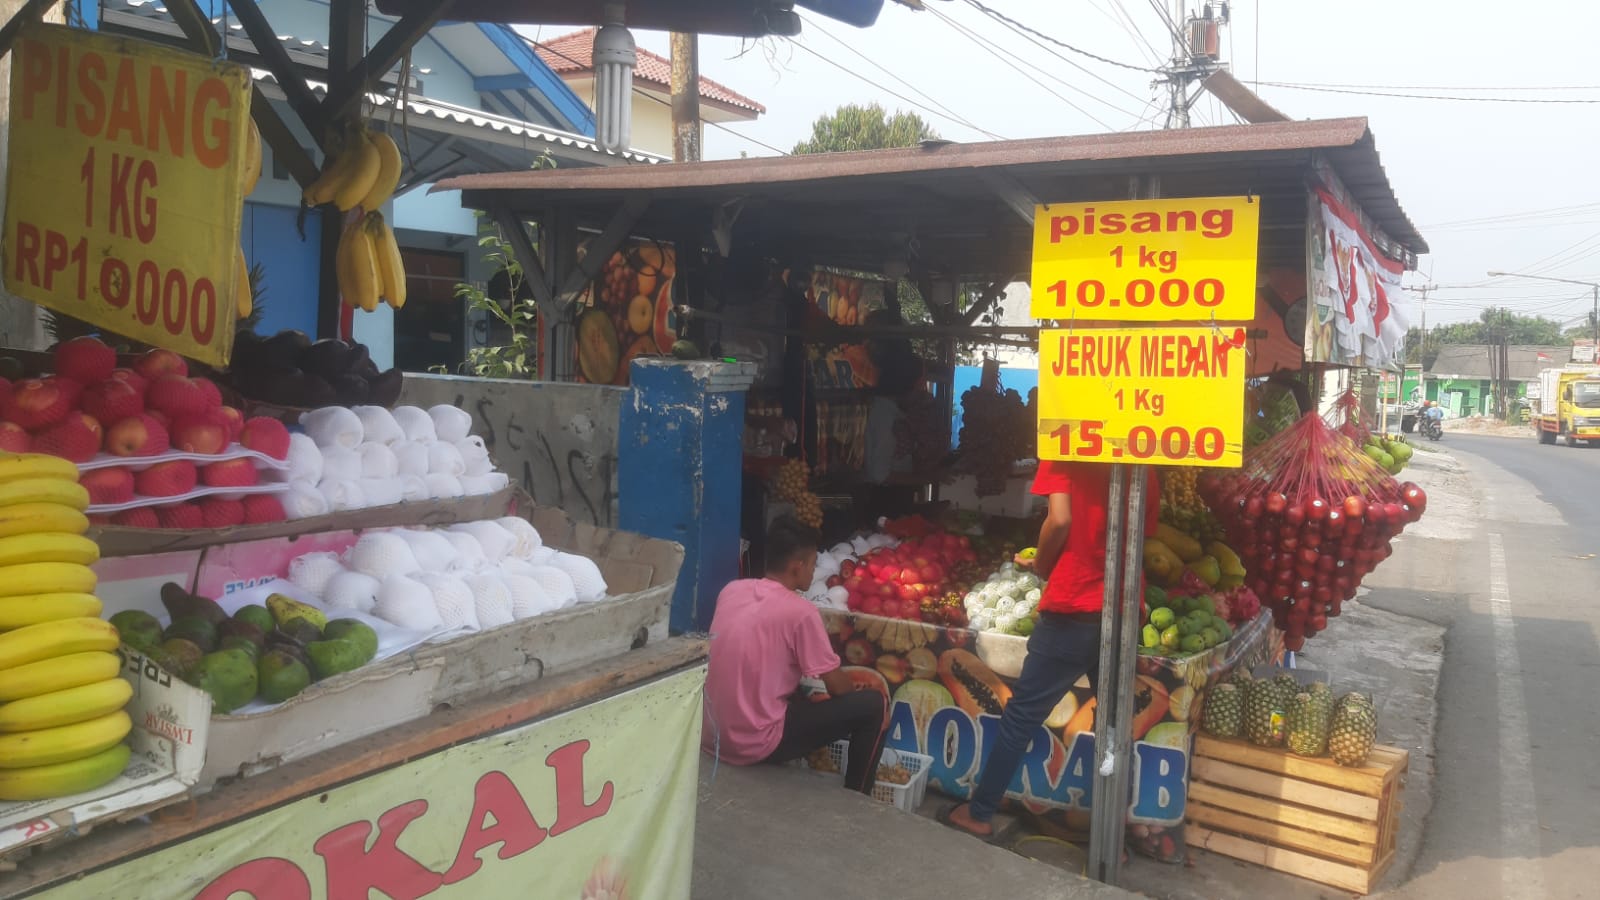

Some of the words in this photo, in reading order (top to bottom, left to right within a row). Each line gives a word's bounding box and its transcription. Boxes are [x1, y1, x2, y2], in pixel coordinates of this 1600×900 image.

[21, 39, 232, 169] PISANG
[81, 147, 96, 228] 1
[109, 153, 158, 244] KG
[1050, 207, 1233, 243] pisang
[1109, 246, 1123, 268] 1
[1139, 246, 1177, 273] kg
[1047, 278, 1225, 307] 10.000
[1052, 336, 1131, 377] JERUK
[1140, 336, 1228, 377] MEDAN
[1114, 389, 1124, 410] 1
[1135, 389, 1164, 416] Kg
[1050, 420, 1225, 460] 15.000
